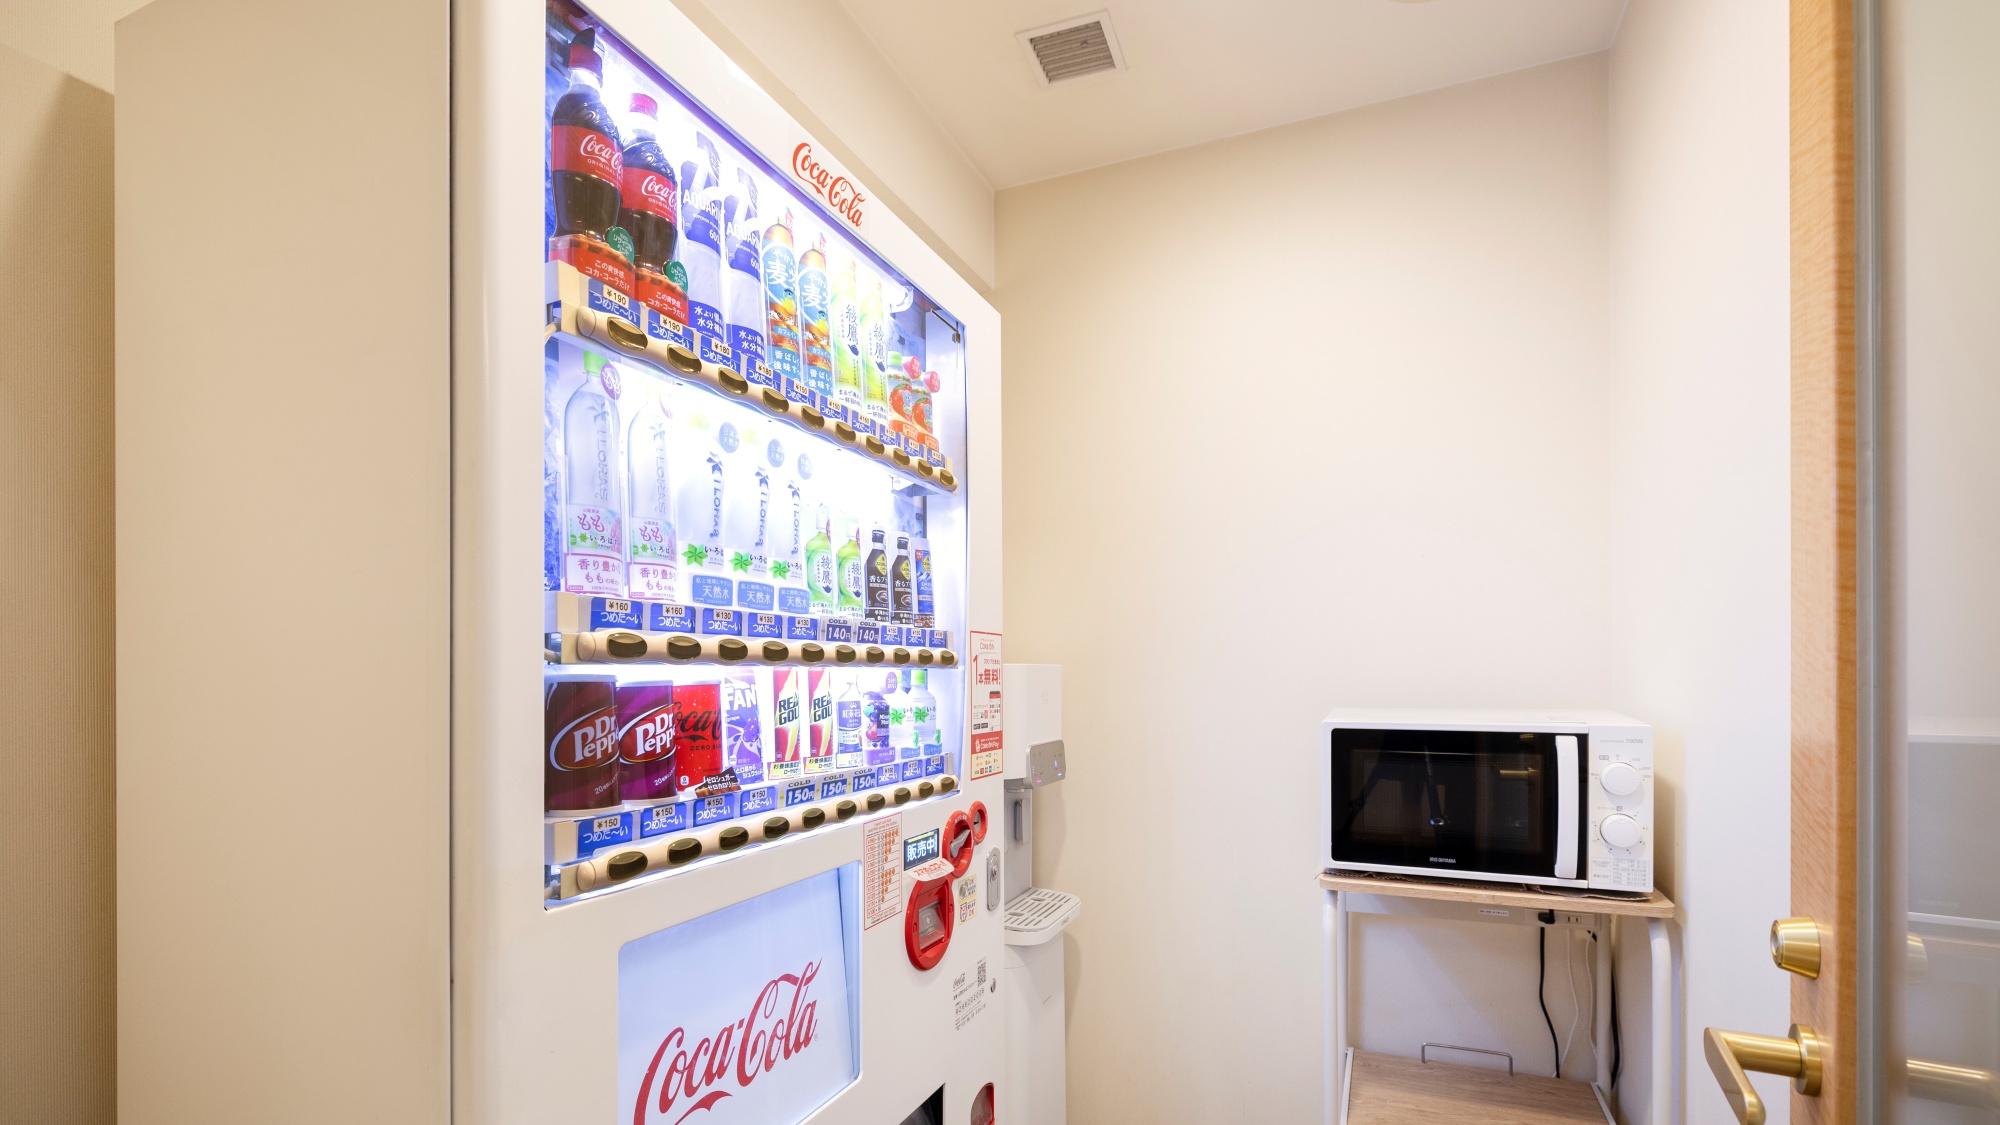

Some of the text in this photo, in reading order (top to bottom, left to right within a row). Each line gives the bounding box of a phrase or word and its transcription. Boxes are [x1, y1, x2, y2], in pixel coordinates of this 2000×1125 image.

[588, 159, 616, 176] ORIGINAL
[793, 143, 865, 228] Coca-Cola
[606, 289, 627, 305] ¥190
[662, 317, 680, 332] ¥190
[714, 342, 730, 355] ¥180
[577, 513, 605, 533] もも
[639, 526, 663, 543] もも
[702, 585, 729, 599] 天然水
[747, 590, 770, 604] 天然水
[608, 601, 628, 611] ¥160
[787, 596, 807, 609] 天然水
[665, 606, 683, 615] ¥160
[715, 611, 731, 620] ¥130
[760, 615, 774, 623] ¥130
[595, 715, 616, 740] Dr
[655, 712, 673, 735] Dr
[788, 780, 811, 788] COLD
[752, 790, 766, 798] ¥150
[787, 789, 814, 805] 150円
[707, 798, 723, 807] ¥150
[655, 807, 673, 817] ¥150
[597, 818, 618, 829] ¥150
[907, 836, 935, 862] 販売中
[634, 957, 823, 1125] Coca-Cola
